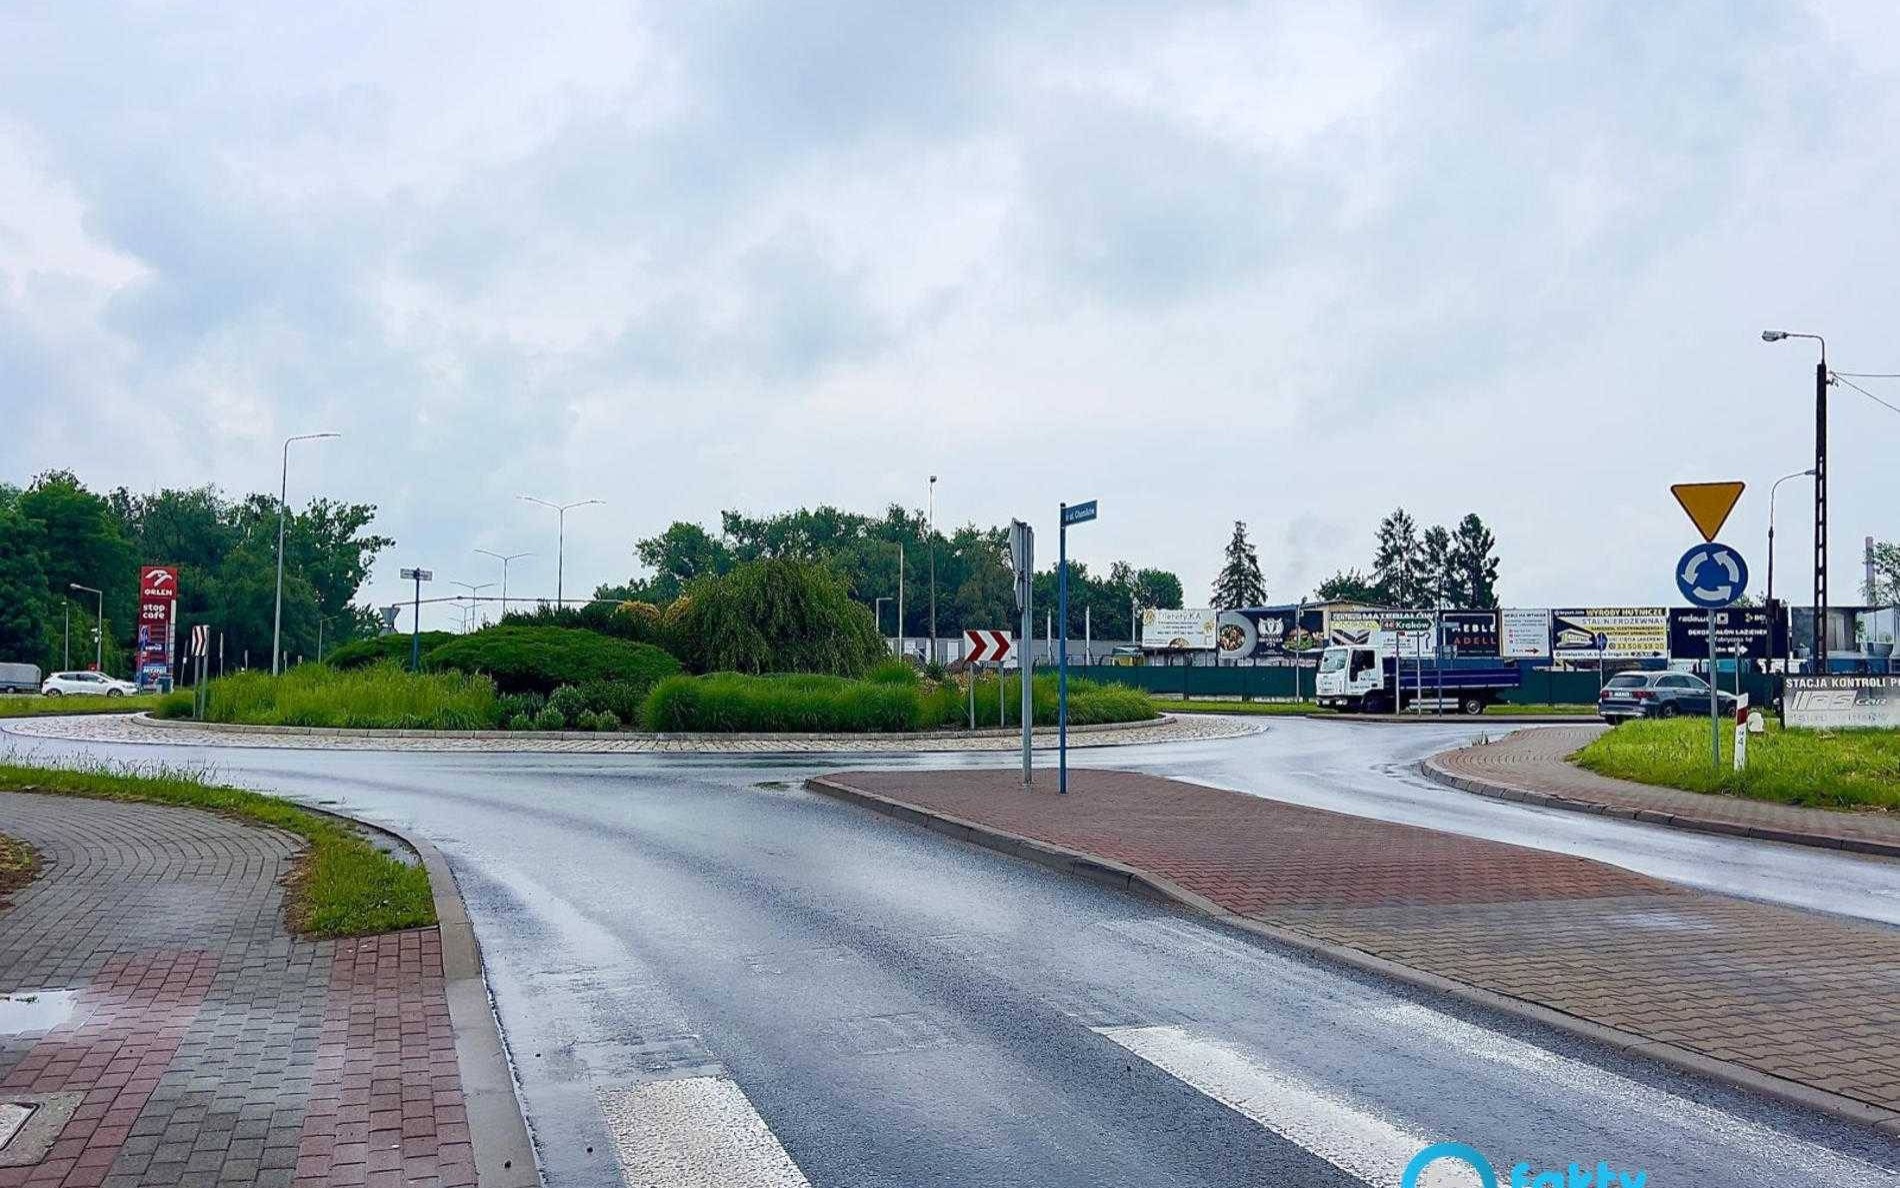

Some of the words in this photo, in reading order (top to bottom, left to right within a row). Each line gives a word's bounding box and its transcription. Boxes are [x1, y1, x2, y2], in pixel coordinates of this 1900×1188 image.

[143, 604, 165, 612] stop
[1396, 621, 1429, 629] Kraków
[1453, 637, 1496, 645] ADELL
[1786, 678, 1827, 688] STACJA
[1831, 678, 1886, 688] KONTROLI
